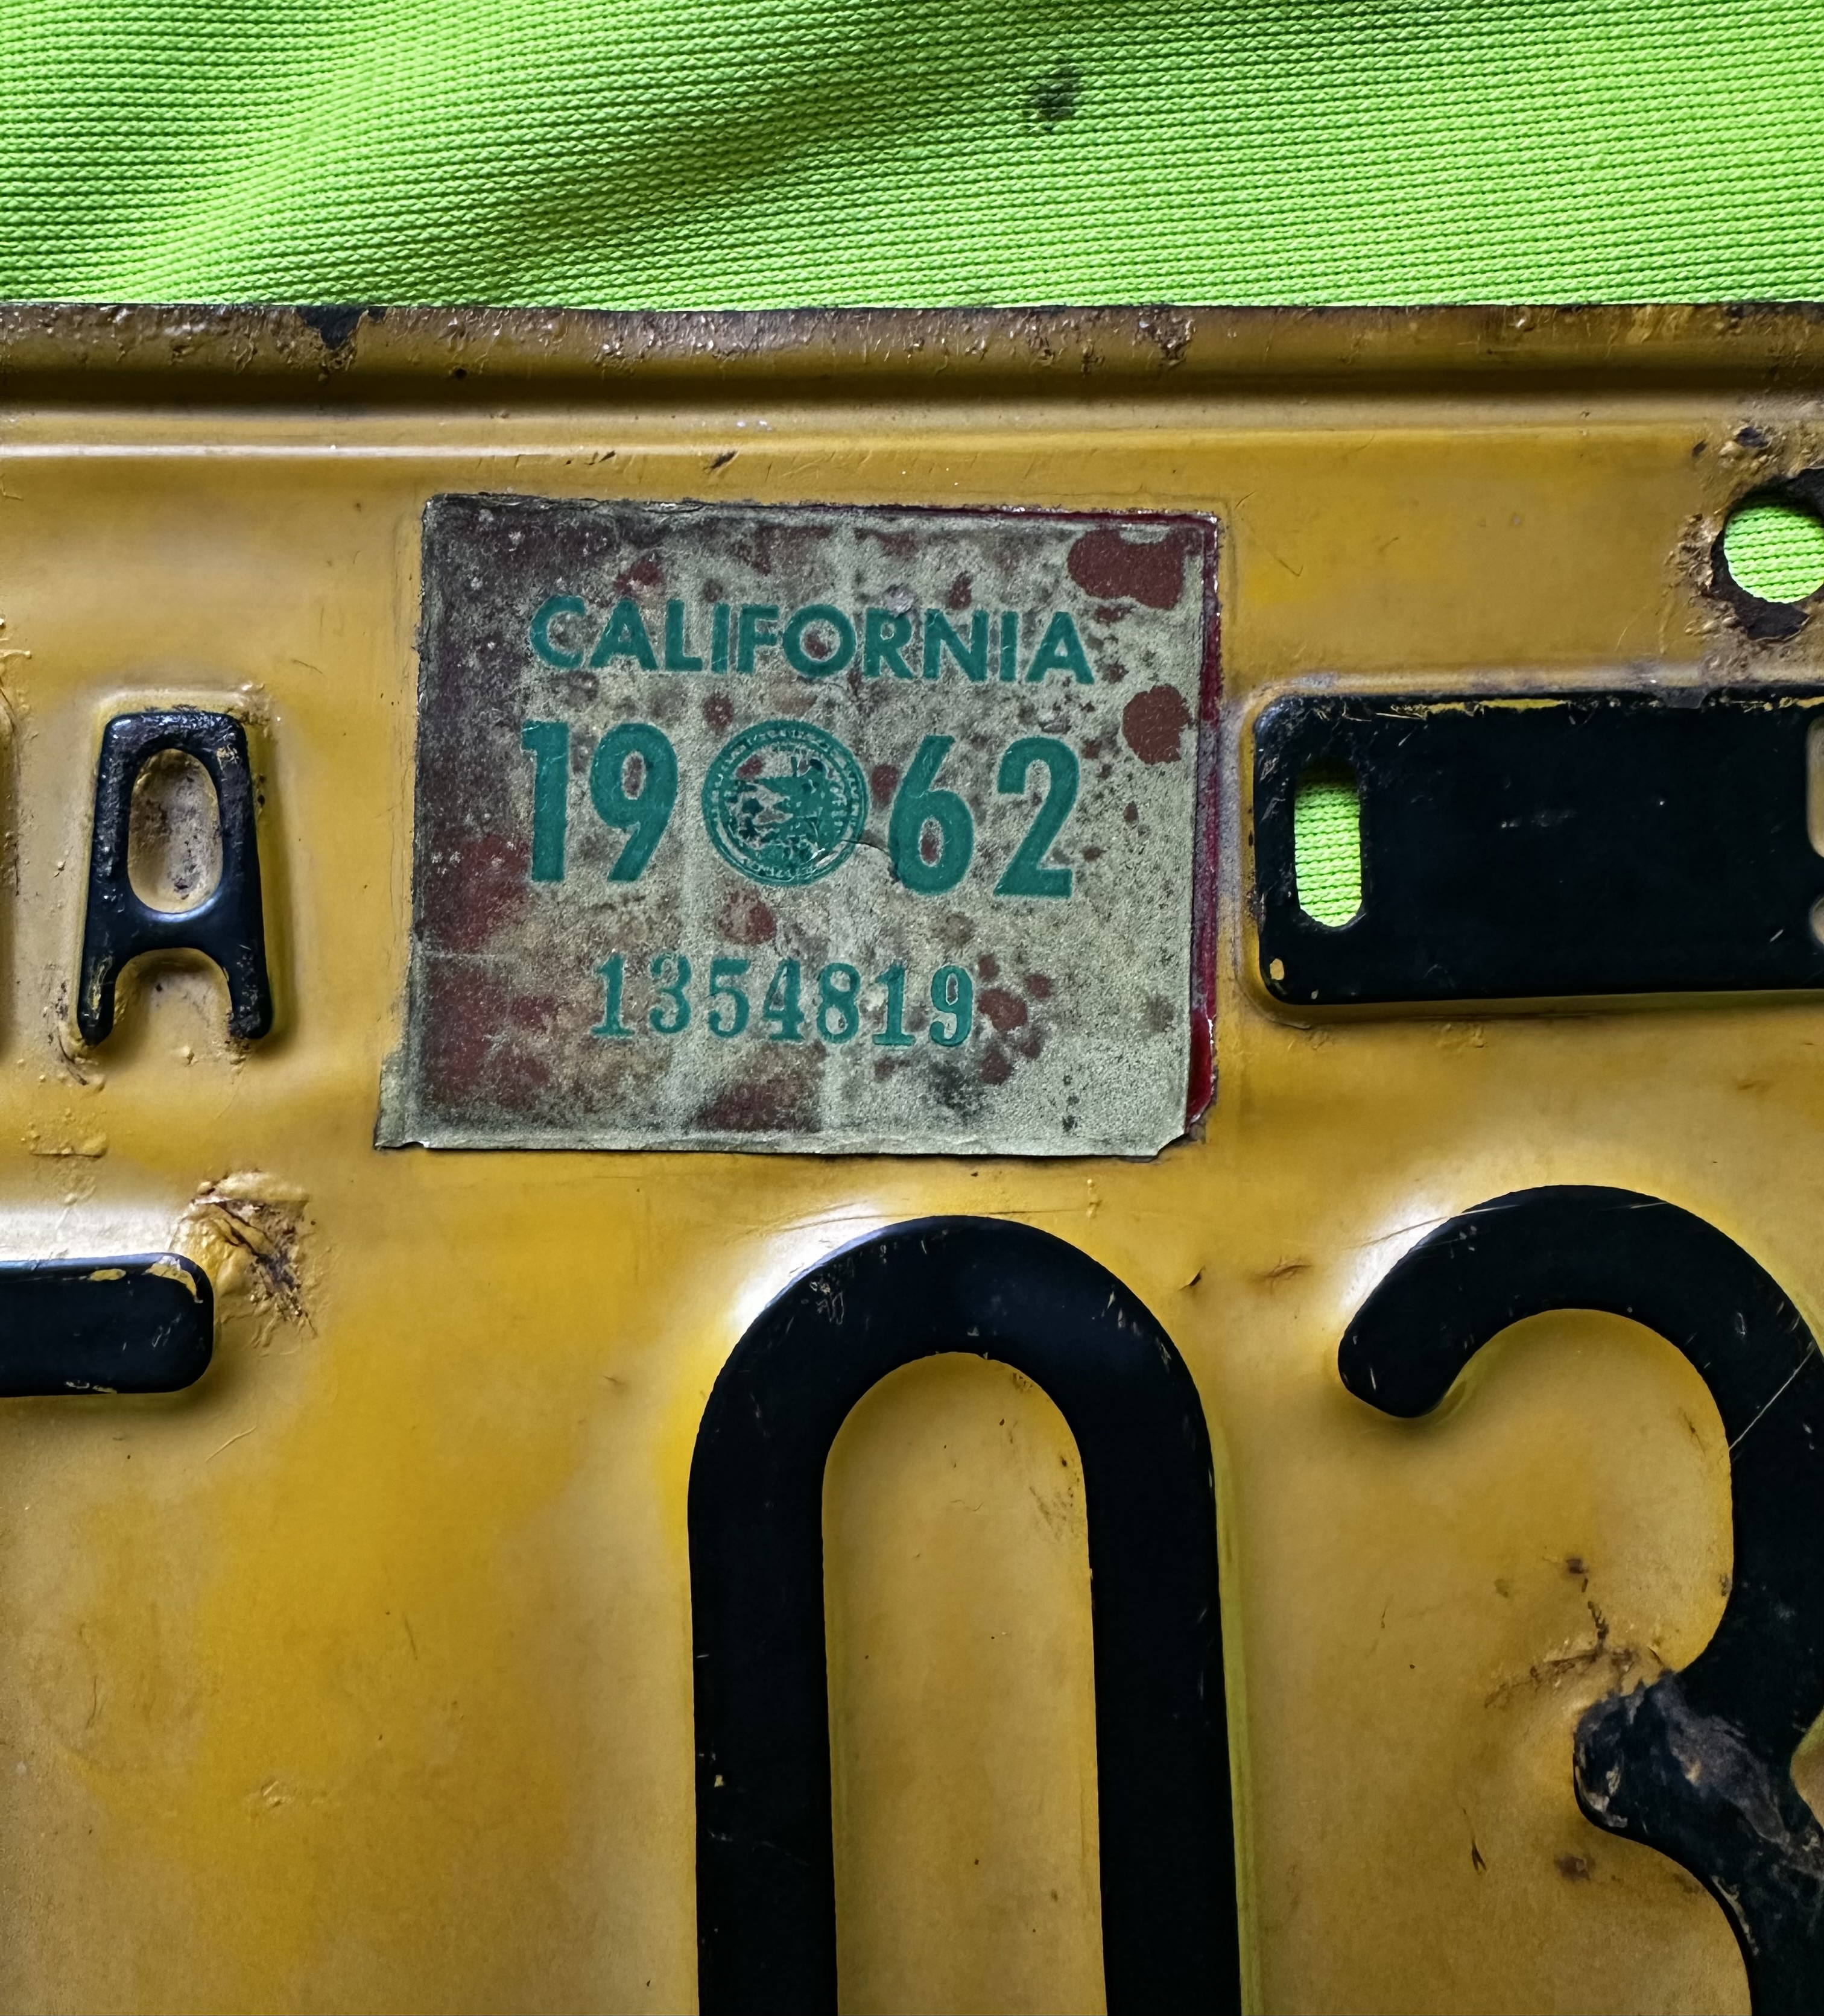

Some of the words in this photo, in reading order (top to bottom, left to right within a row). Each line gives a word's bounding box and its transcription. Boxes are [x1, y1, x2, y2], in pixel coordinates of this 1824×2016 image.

[530, 596, 1095, 685] CALIFORNIA
[521, 721, 679, 883] 19
[889, 735, 1080, 898] 62
[591, 953, 975, 1047] 1354819
